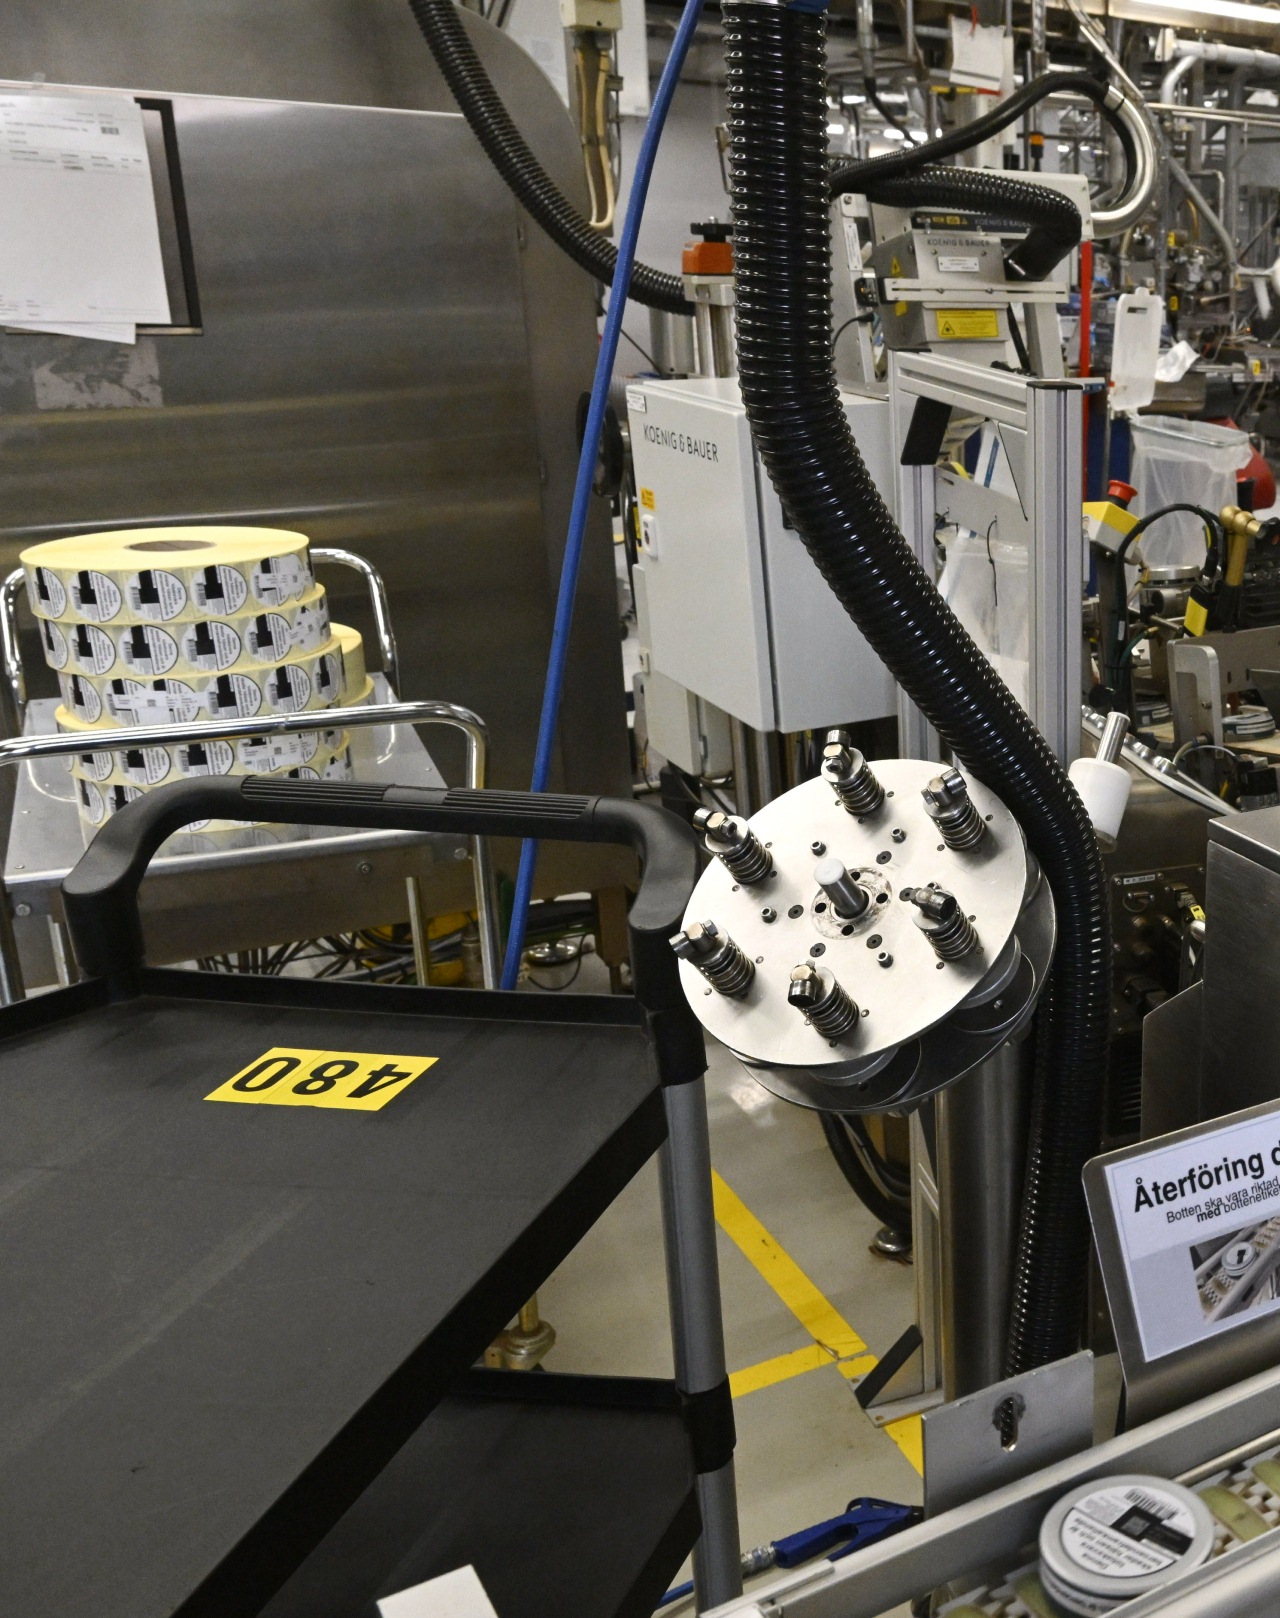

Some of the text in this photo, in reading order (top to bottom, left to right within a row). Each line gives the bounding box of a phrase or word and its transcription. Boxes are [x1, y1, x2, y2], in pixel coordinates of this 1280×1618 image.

[927, 239, 957, 247] KOENIG
[643, 423, 719, 463] KOENIG & BAUER
[231, 1056, 414, 1099] 480
[1134, 1151, 1266, 1213] Återföring
[1166, 1203, 1202, 1224] Botten
[1204, 1194, 1224, 1212] ska
[1224, 1187, 1249, 1203] vara
[1251, 1175, 1279, 1195] riktad
[1196, 1205, 1222, 1224] med
